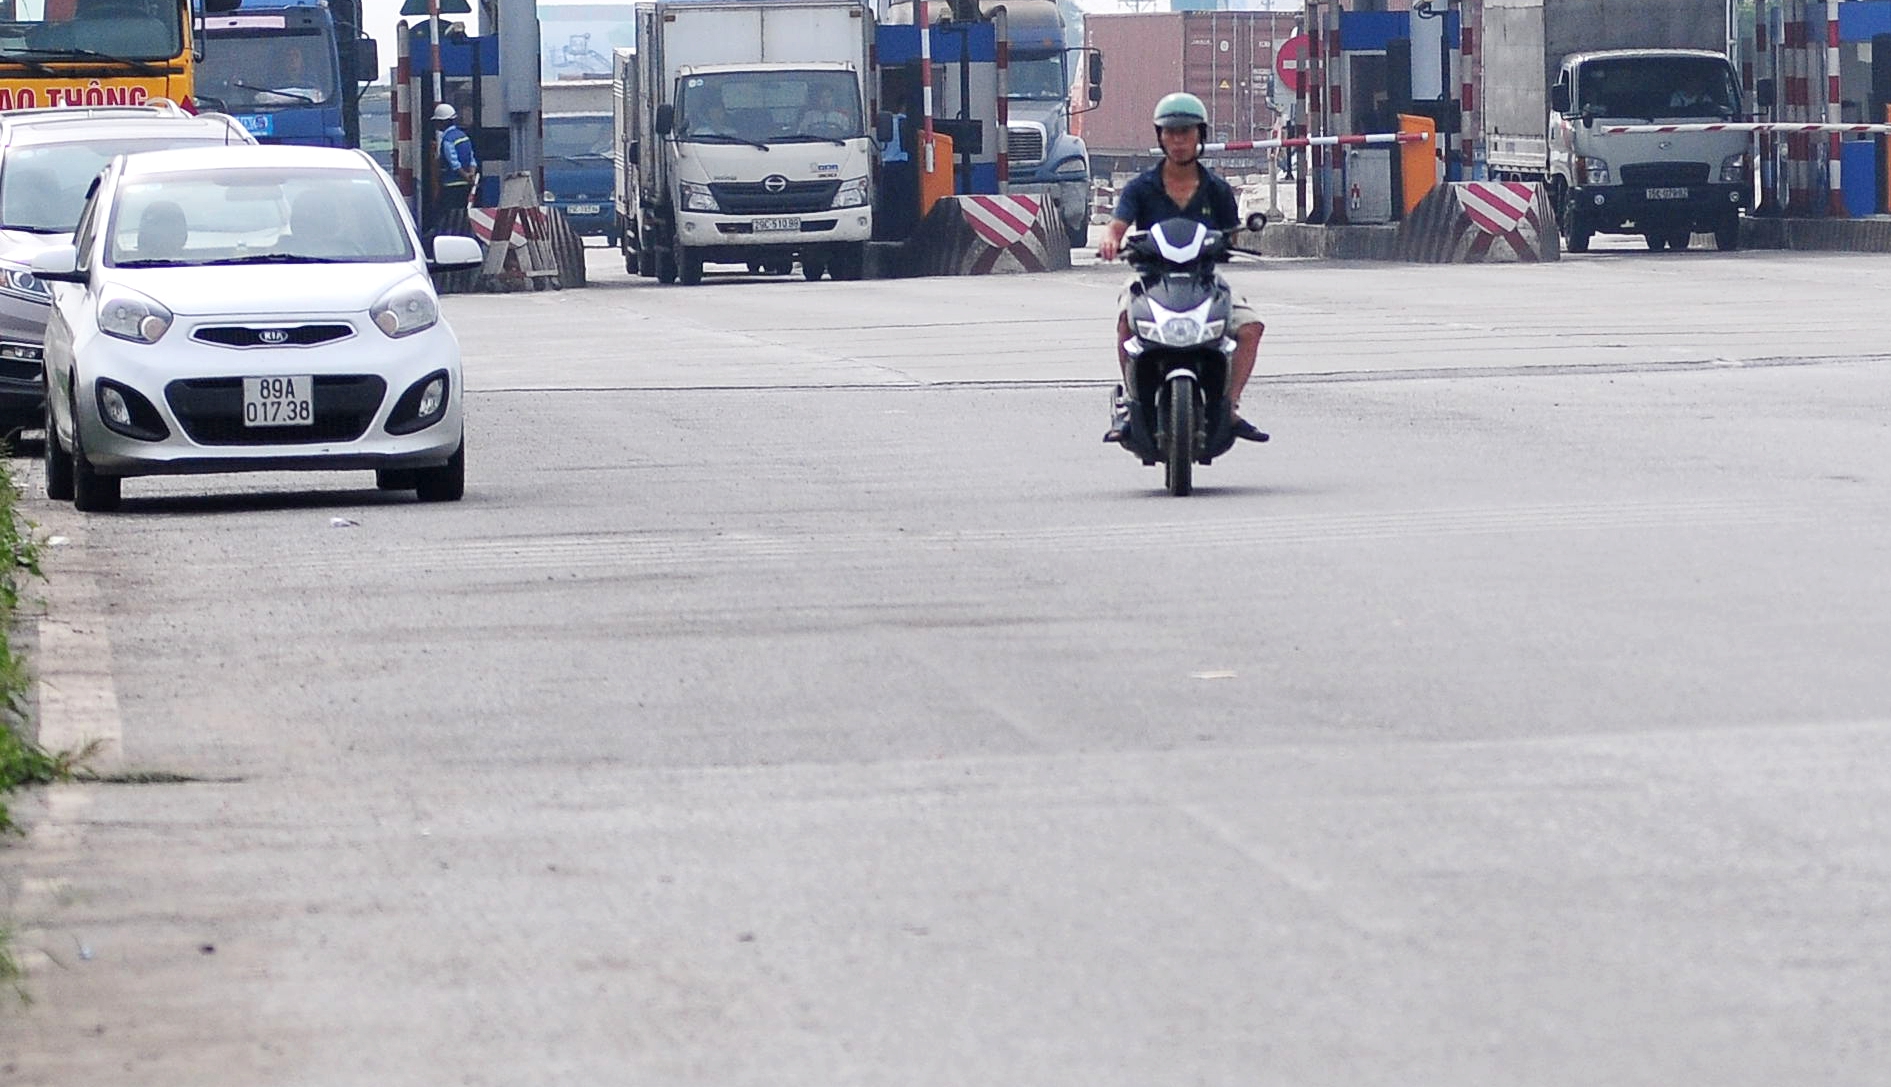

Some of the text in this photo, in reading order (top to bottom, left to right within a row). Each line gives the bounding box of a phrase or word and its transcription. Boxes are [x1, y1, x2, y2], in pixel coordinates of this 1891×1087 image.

[264, 331, 284, 340] KIA
[260, 378, 295, 400] 89A
[247, 400, 310, 422] 017.38
